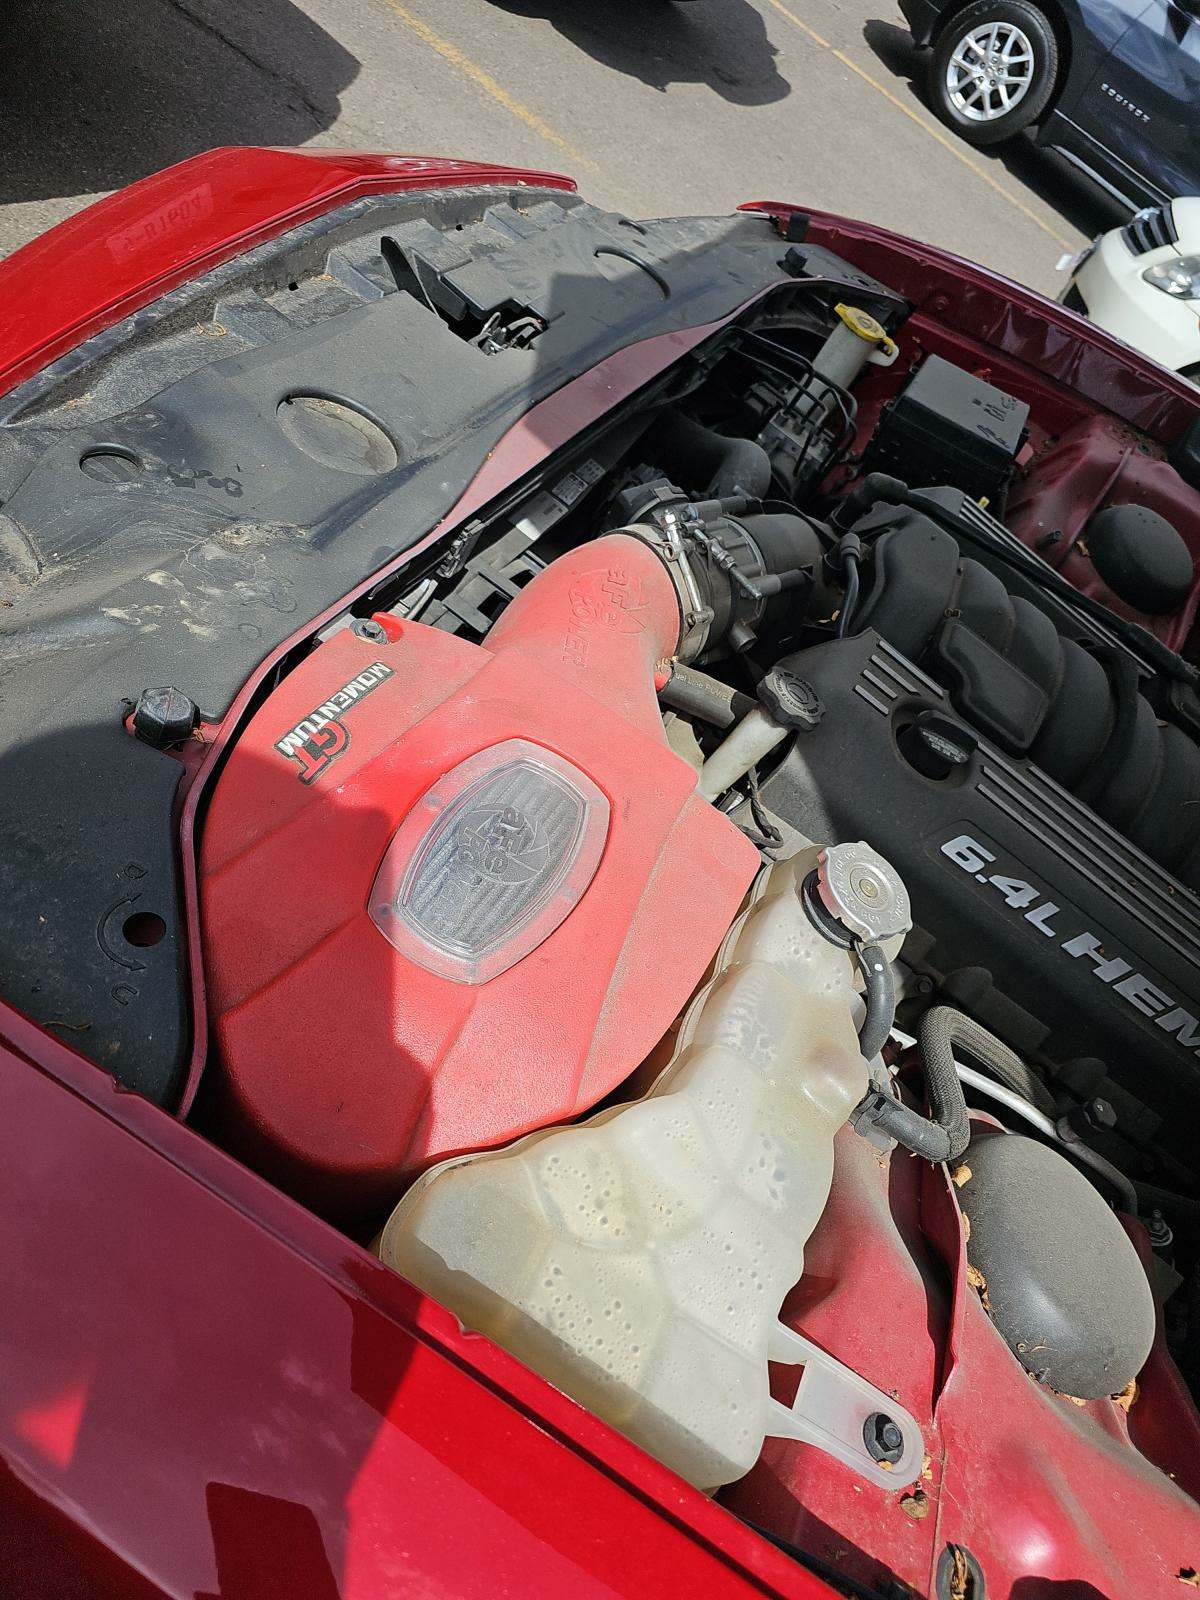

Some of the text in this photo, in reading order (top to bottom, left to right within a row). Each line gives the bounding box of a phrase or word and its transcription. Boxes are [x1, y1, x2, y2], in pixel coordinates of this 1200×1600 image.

[277, 662, 393, 757] MOMENTUM
[295, 721, 347, 780] GT
[940, 834, 1200, 1058] 6.4L HEM
